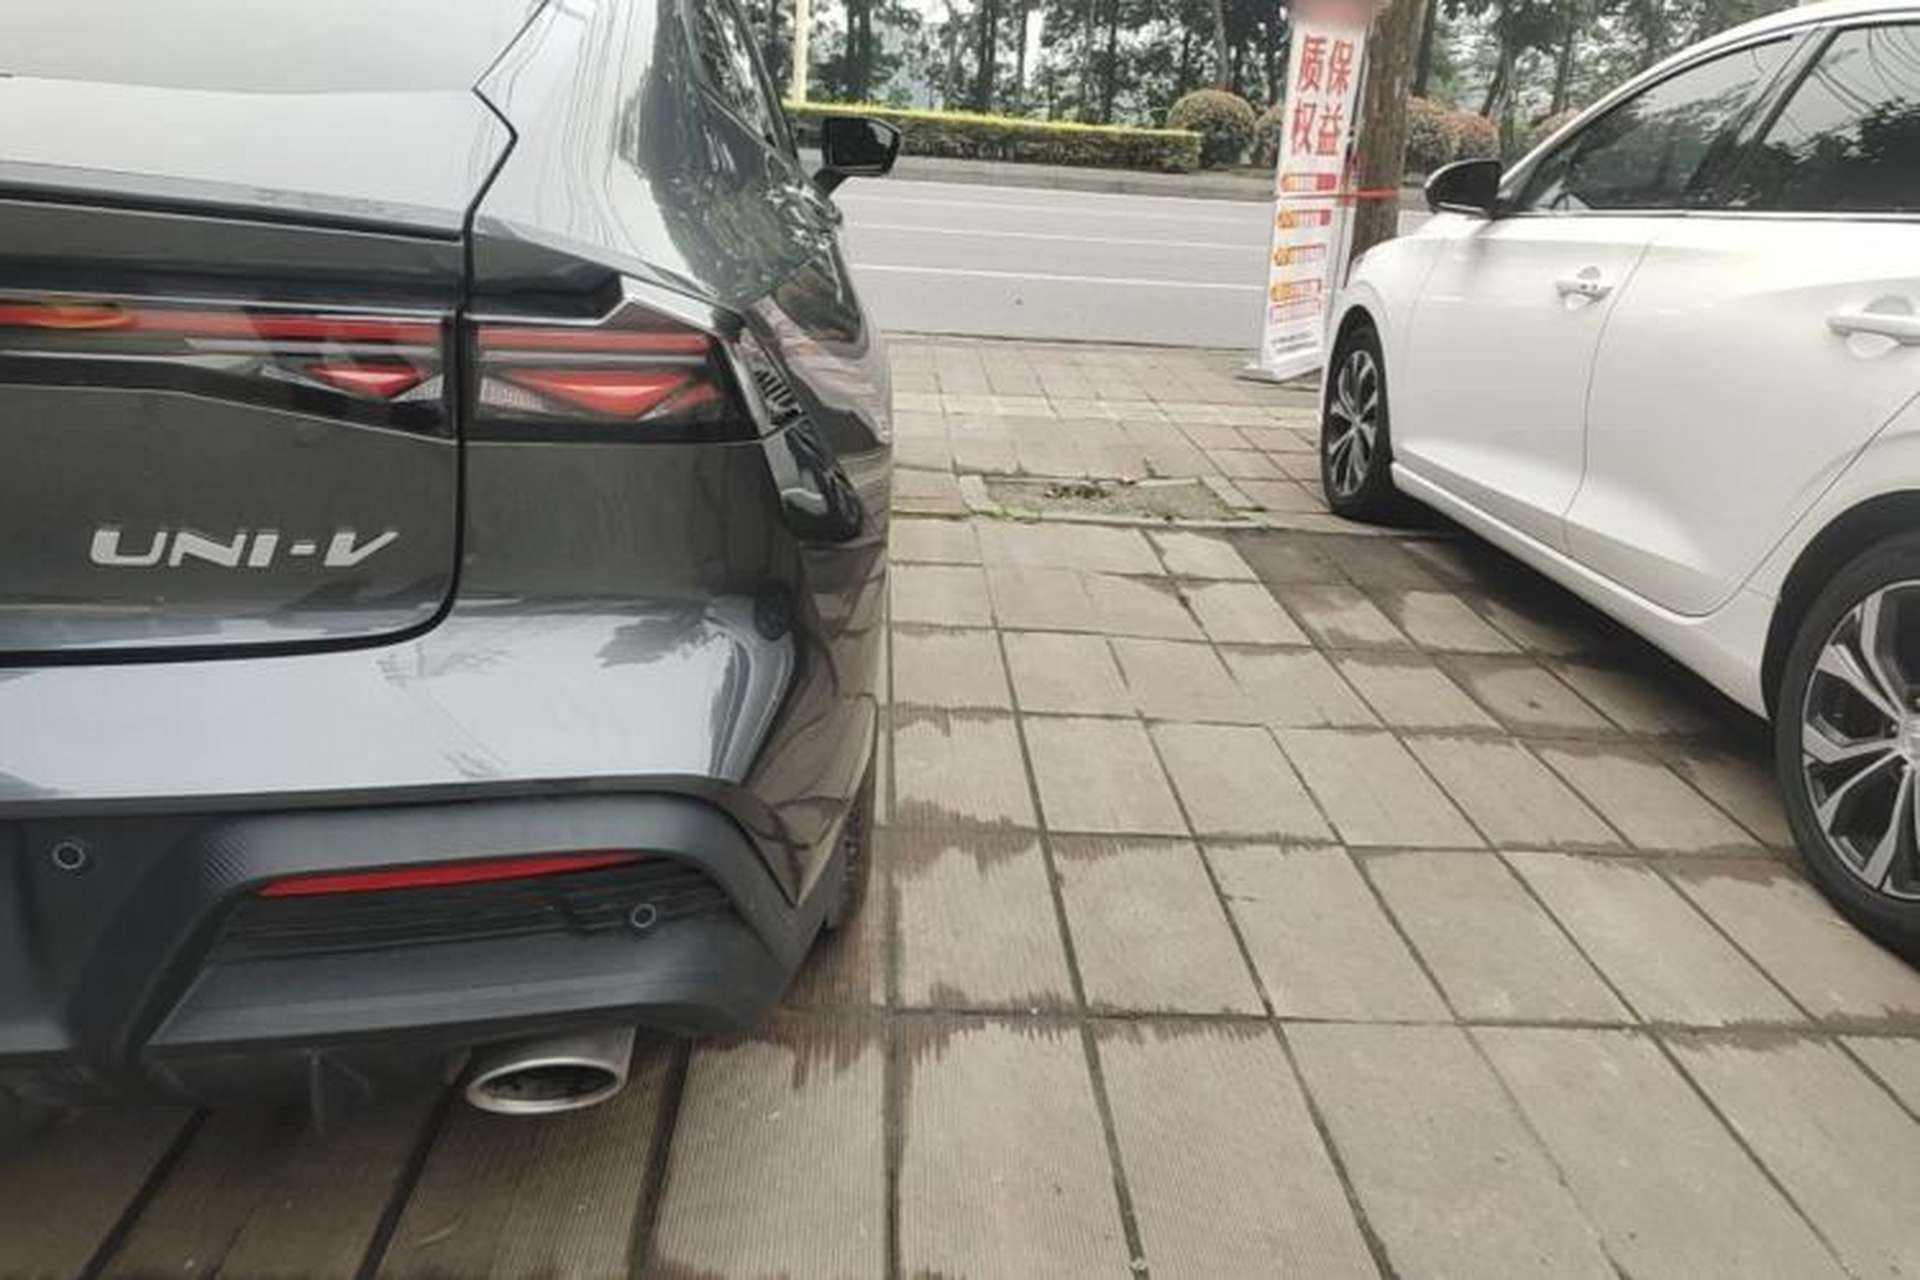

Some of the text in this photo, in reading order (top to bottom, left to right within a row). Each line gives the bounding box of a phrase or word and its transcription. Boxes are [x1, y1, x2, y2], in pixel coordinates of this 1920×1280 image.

[1298, 34, 1354, 94] 质保
[1291, 99, 1342, 155] 权益
[90, 530, 399, 567] UNI-V
